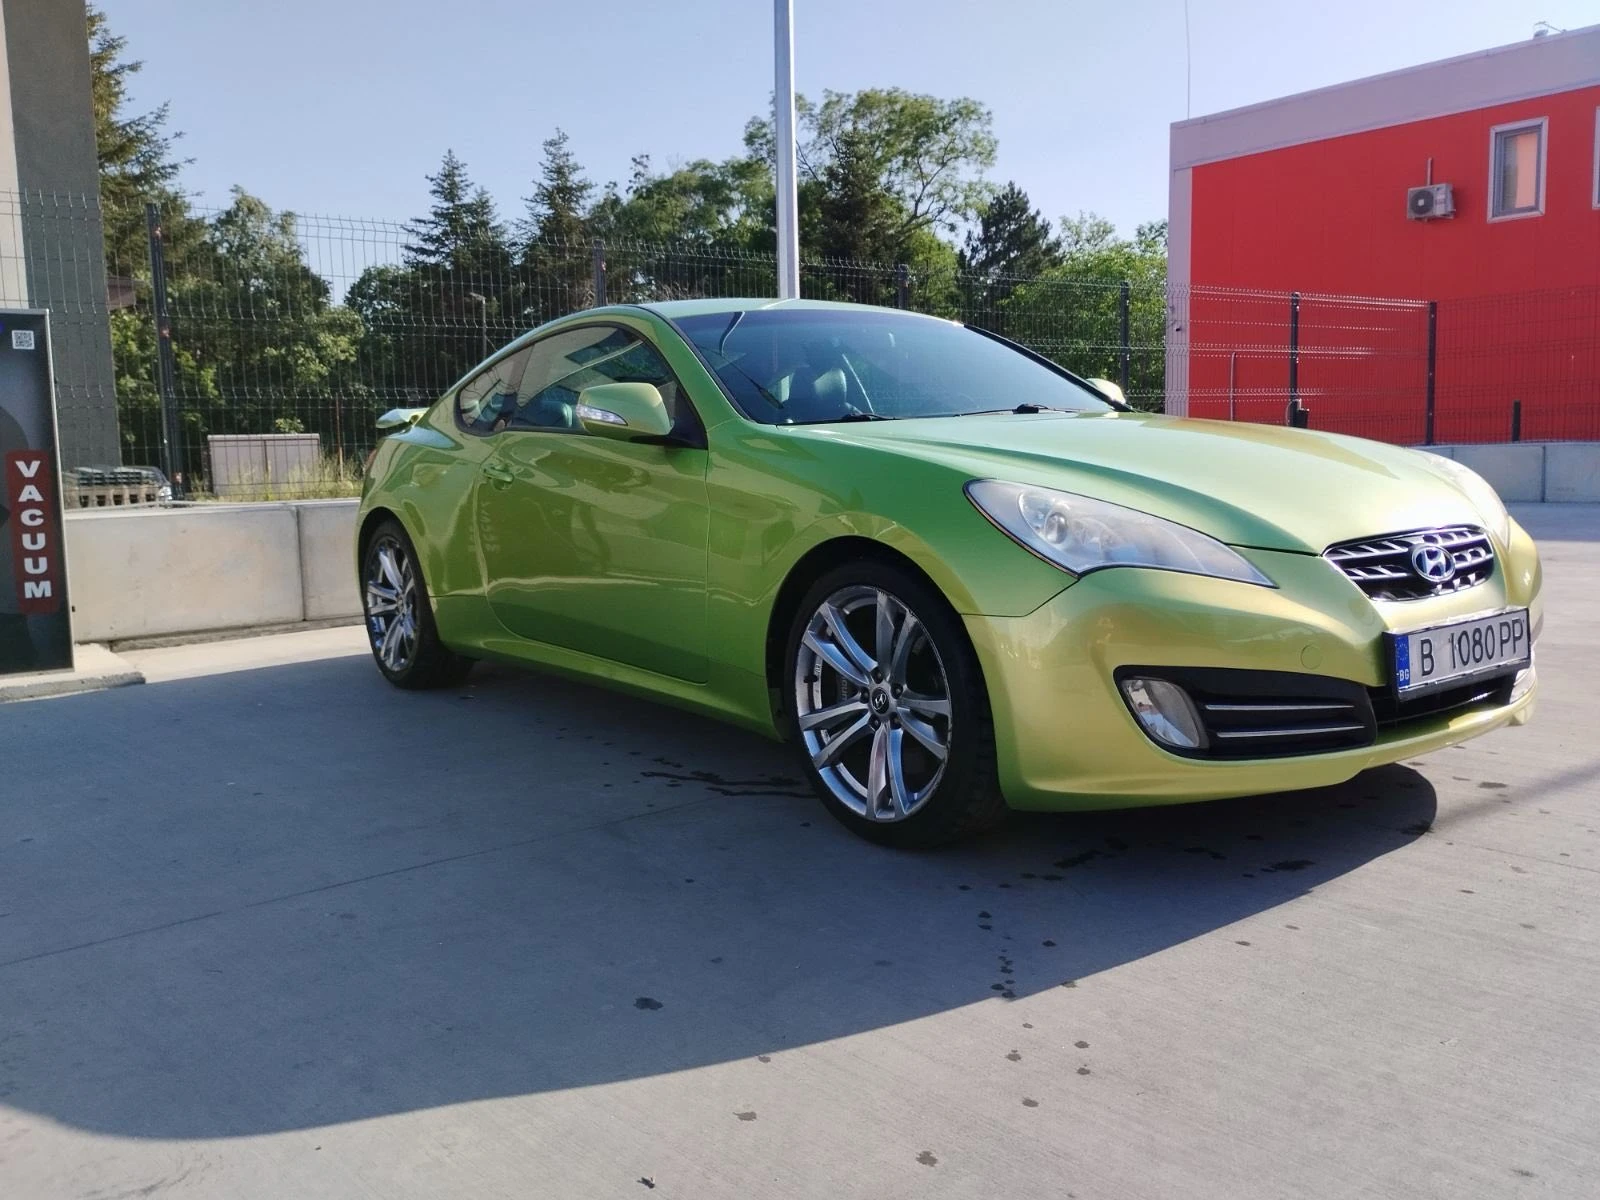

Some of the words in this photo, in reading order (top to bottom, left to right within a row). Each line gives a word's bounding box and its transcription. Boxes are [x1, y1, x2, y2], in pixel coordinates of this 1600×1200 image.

[15, 460, 51, 598] VACUUM
[1399, 669, 1410, 682] BG
[1420, 638, 1435, 677] B
[1449, 625, 1496, 669] 1080
[1500, 618, 1524, 657] PP
